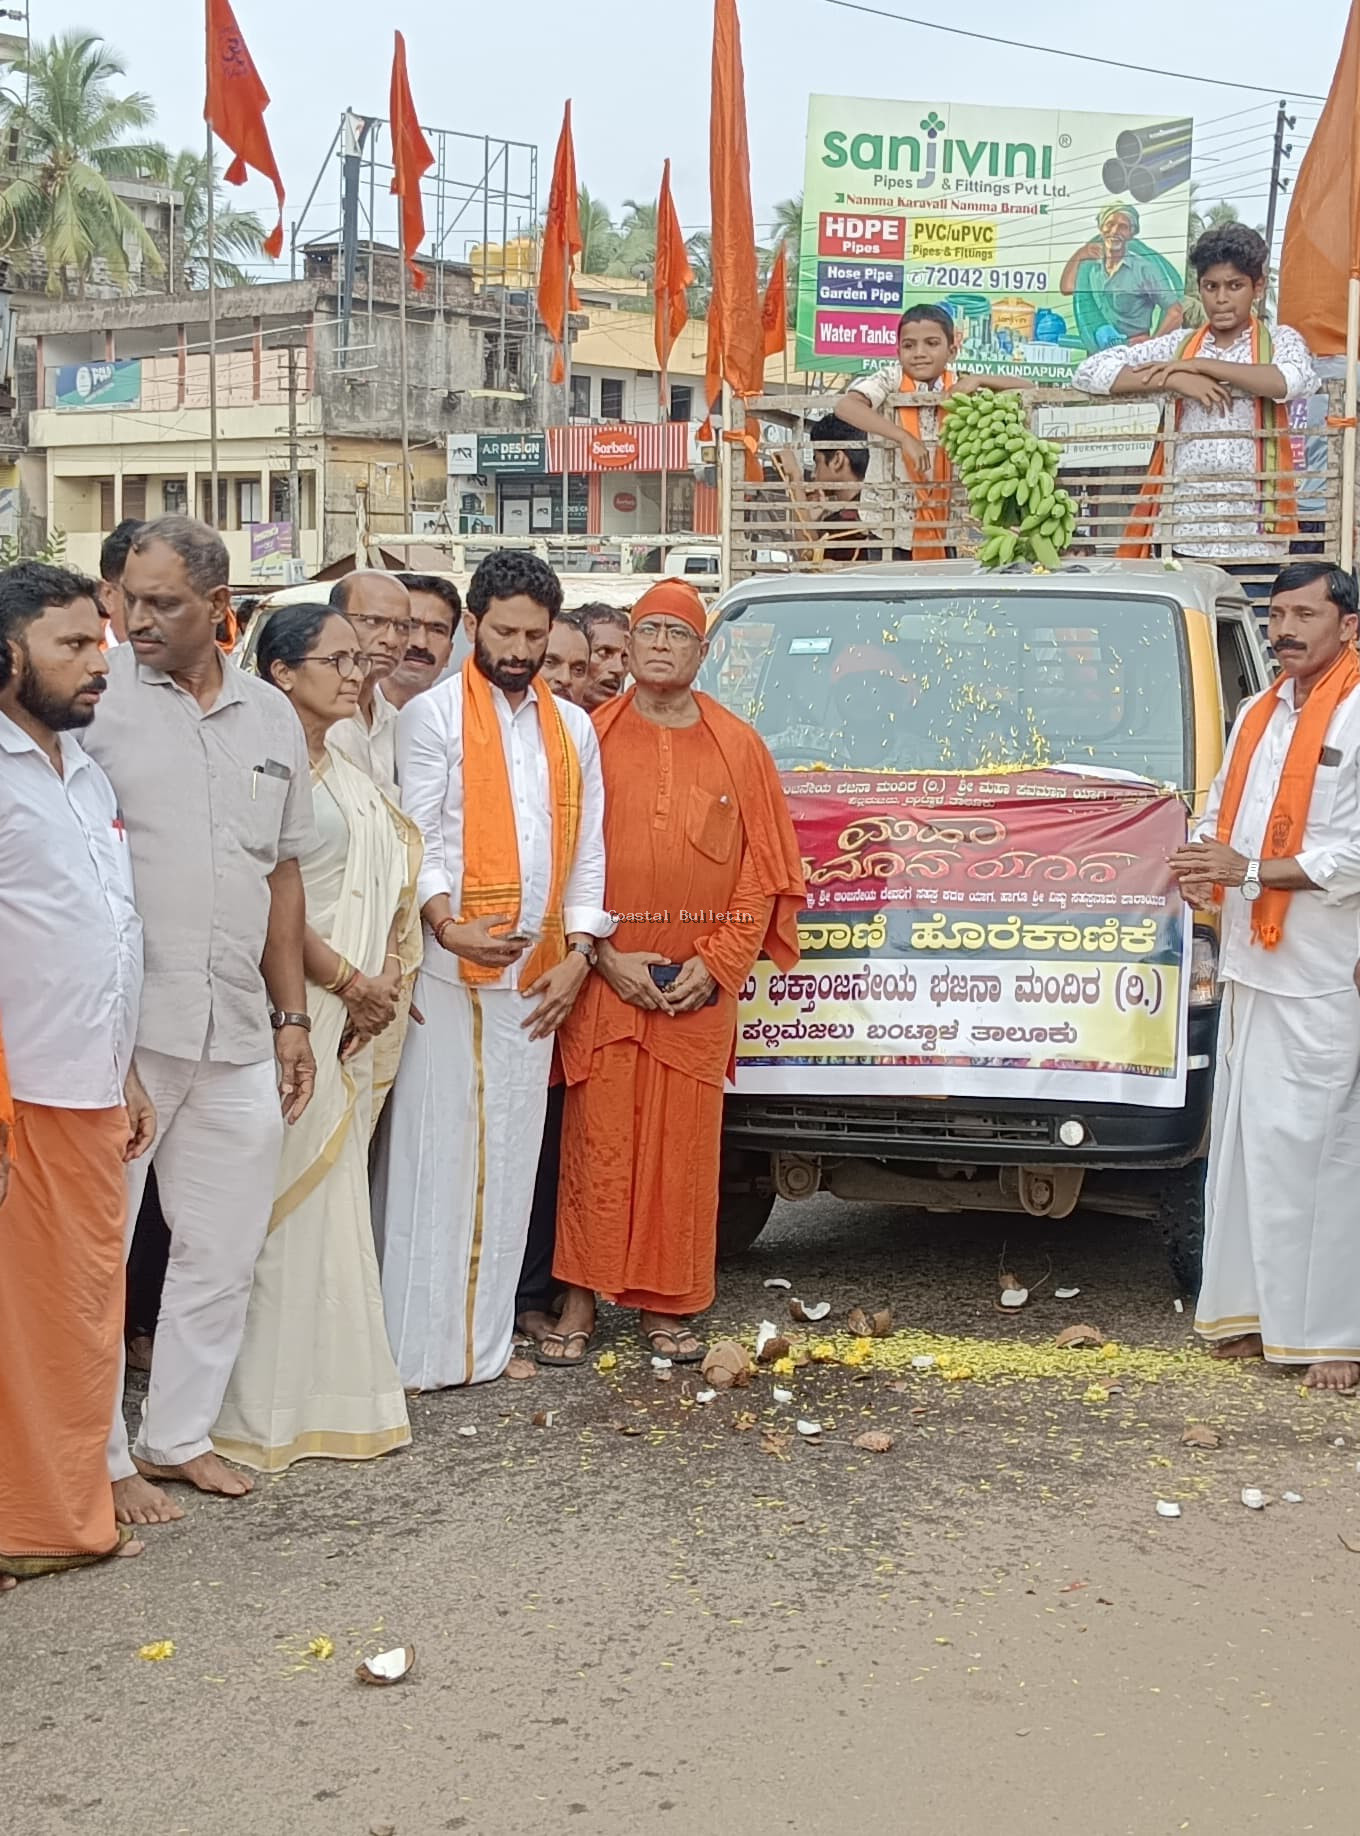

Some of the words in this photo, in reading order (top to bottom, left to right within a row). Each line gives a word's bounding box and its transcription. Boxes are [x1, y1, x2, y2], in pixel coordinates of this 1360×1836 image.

[873, 174, 913, 190] Pipes
[941, 178, 951, 190] &
[955, 179, 1010, 196] Fittings
[1014, 182, 1038, 196] Pvt
[1042, 184, 1071, 197] Ltd.
[846, 194, 894, 207] Namma
[950, 199, 997, 213] Namma
[1001, 202, 1038, 215] Brand
[825, 216, 899, 241] HDPE
[914, 222, 994, 243] PVC/uPVC
[842, 241, 881, 254] Pipes
[912, 244, 941, 257] Pipes
[944, 245, 951, 257] &
[954, 247, 993, 260] Fittings
[827, 266, 861, 280] Hose
[864, 268, 894, 281] Pipe
[925, 266, 983, 287] 72042
[989, 269, 1048, 290] 91979
[819, 287, 868, 300] Garden
[871, 289, 900, 303] Pipe
[819, 322, 857, 343] Water
[860, 325, 897, 345] Tanks
[997, 364, 1073, 378] KUNDAPURA
[500, 437, 540, 455] DESIGN
[593, 441, 635, 455] Sorbete
[957, 779, 974, 796] ಶ್ರೀ
[979, 780, 1010, 794] ಮಹಾ
[797, 913, 888, 950] ವಾಣಿ
[911, 912, 1157, 953] ಹೊರೆಕಾಣಿಕೆ
[768, 963, 917, 1013] ಭಕ್ತಾಂಜನೇಯ
[929, 963, 1001, 1007] ಭಜನಾ
[1014, 965, 1101, 1005] ಮಂದಿರ
[1115, 966, 1163, 1015] (ರಿ.)
[742, 1018, 855, 1048] ಪಲ್ಲಮಜಲು
[971, 1021, 1079, 1044] ತಾಲೂಕು
